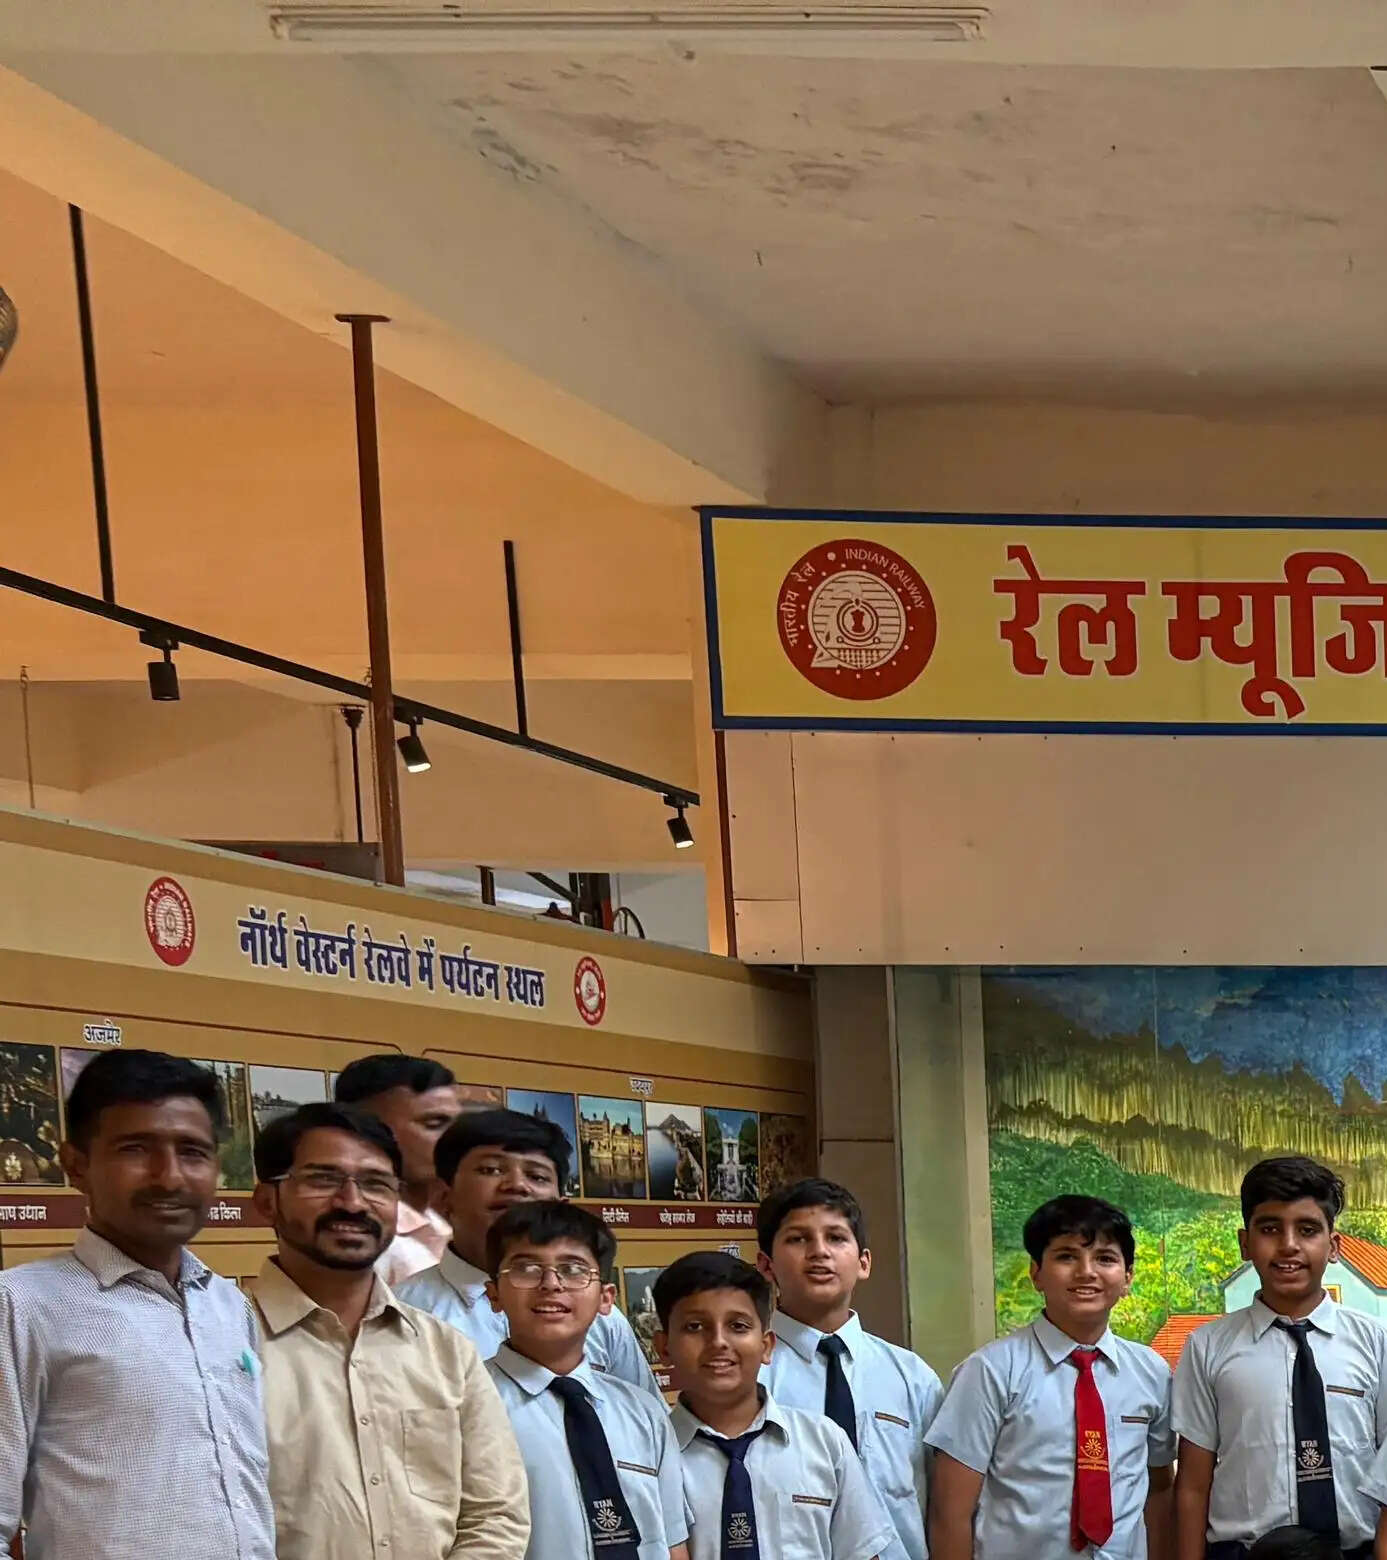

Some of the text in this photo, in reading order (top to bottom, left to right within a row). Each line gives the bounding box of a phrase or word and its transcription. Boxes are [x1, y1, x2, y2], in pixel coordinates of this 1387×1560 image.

[845, 548, 925, 610] INDIAN RAILWAY
[992, 544, 1146, 679] रेल
[237, 907, 288, 968] नॉर्थ
[293, 916, 357, 978] वेस्टर्न
[362, 927, 411, 987] रेलवे
[416, 938, 435, 991] में
[440, 945, 500, 1000] पर्यटन
[504, 965, 545, 1007] स्थल
[84, 1019, 121, 1044] अजमेर
